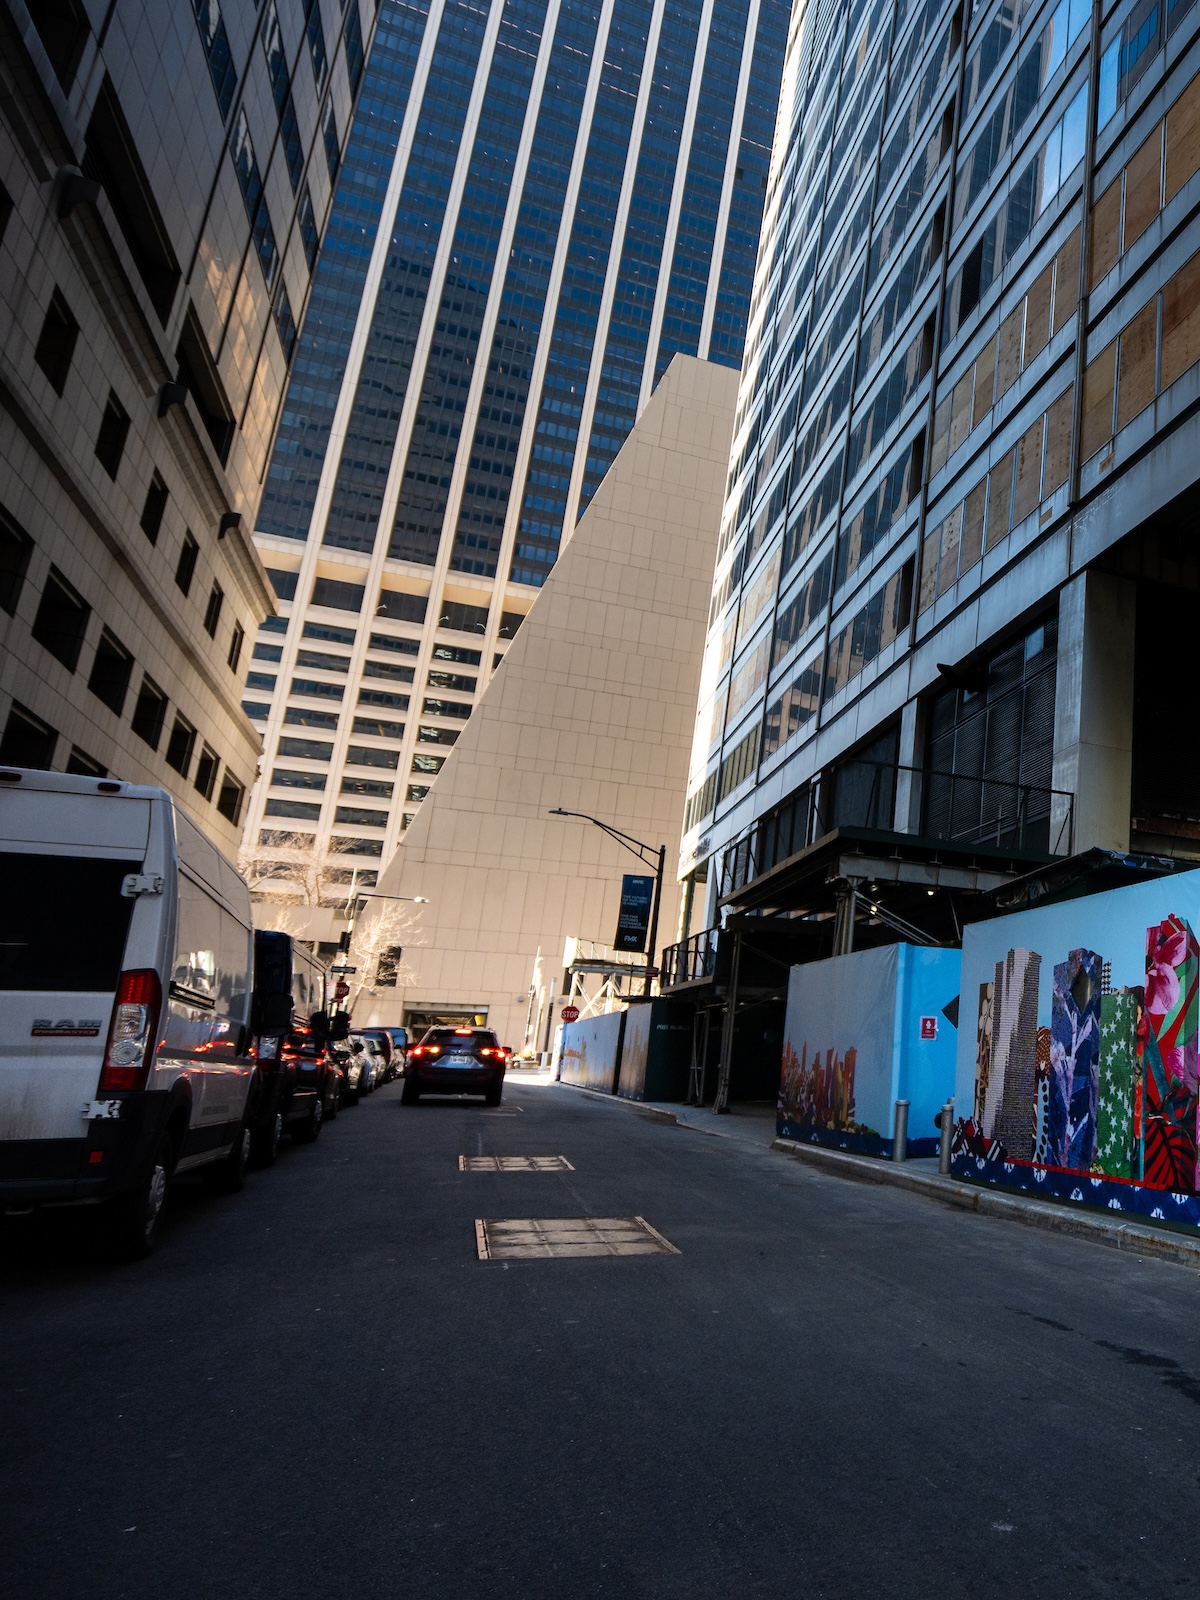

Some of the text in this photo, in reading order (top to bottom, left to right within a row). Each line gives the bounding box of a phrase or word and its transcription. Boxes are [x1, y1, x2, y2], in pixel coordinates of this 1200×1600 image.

[335, 986, 349, 995] TOP
[562, 1010, 579, 1018] STOP
[32, 1019, 103, 1028] RAM
